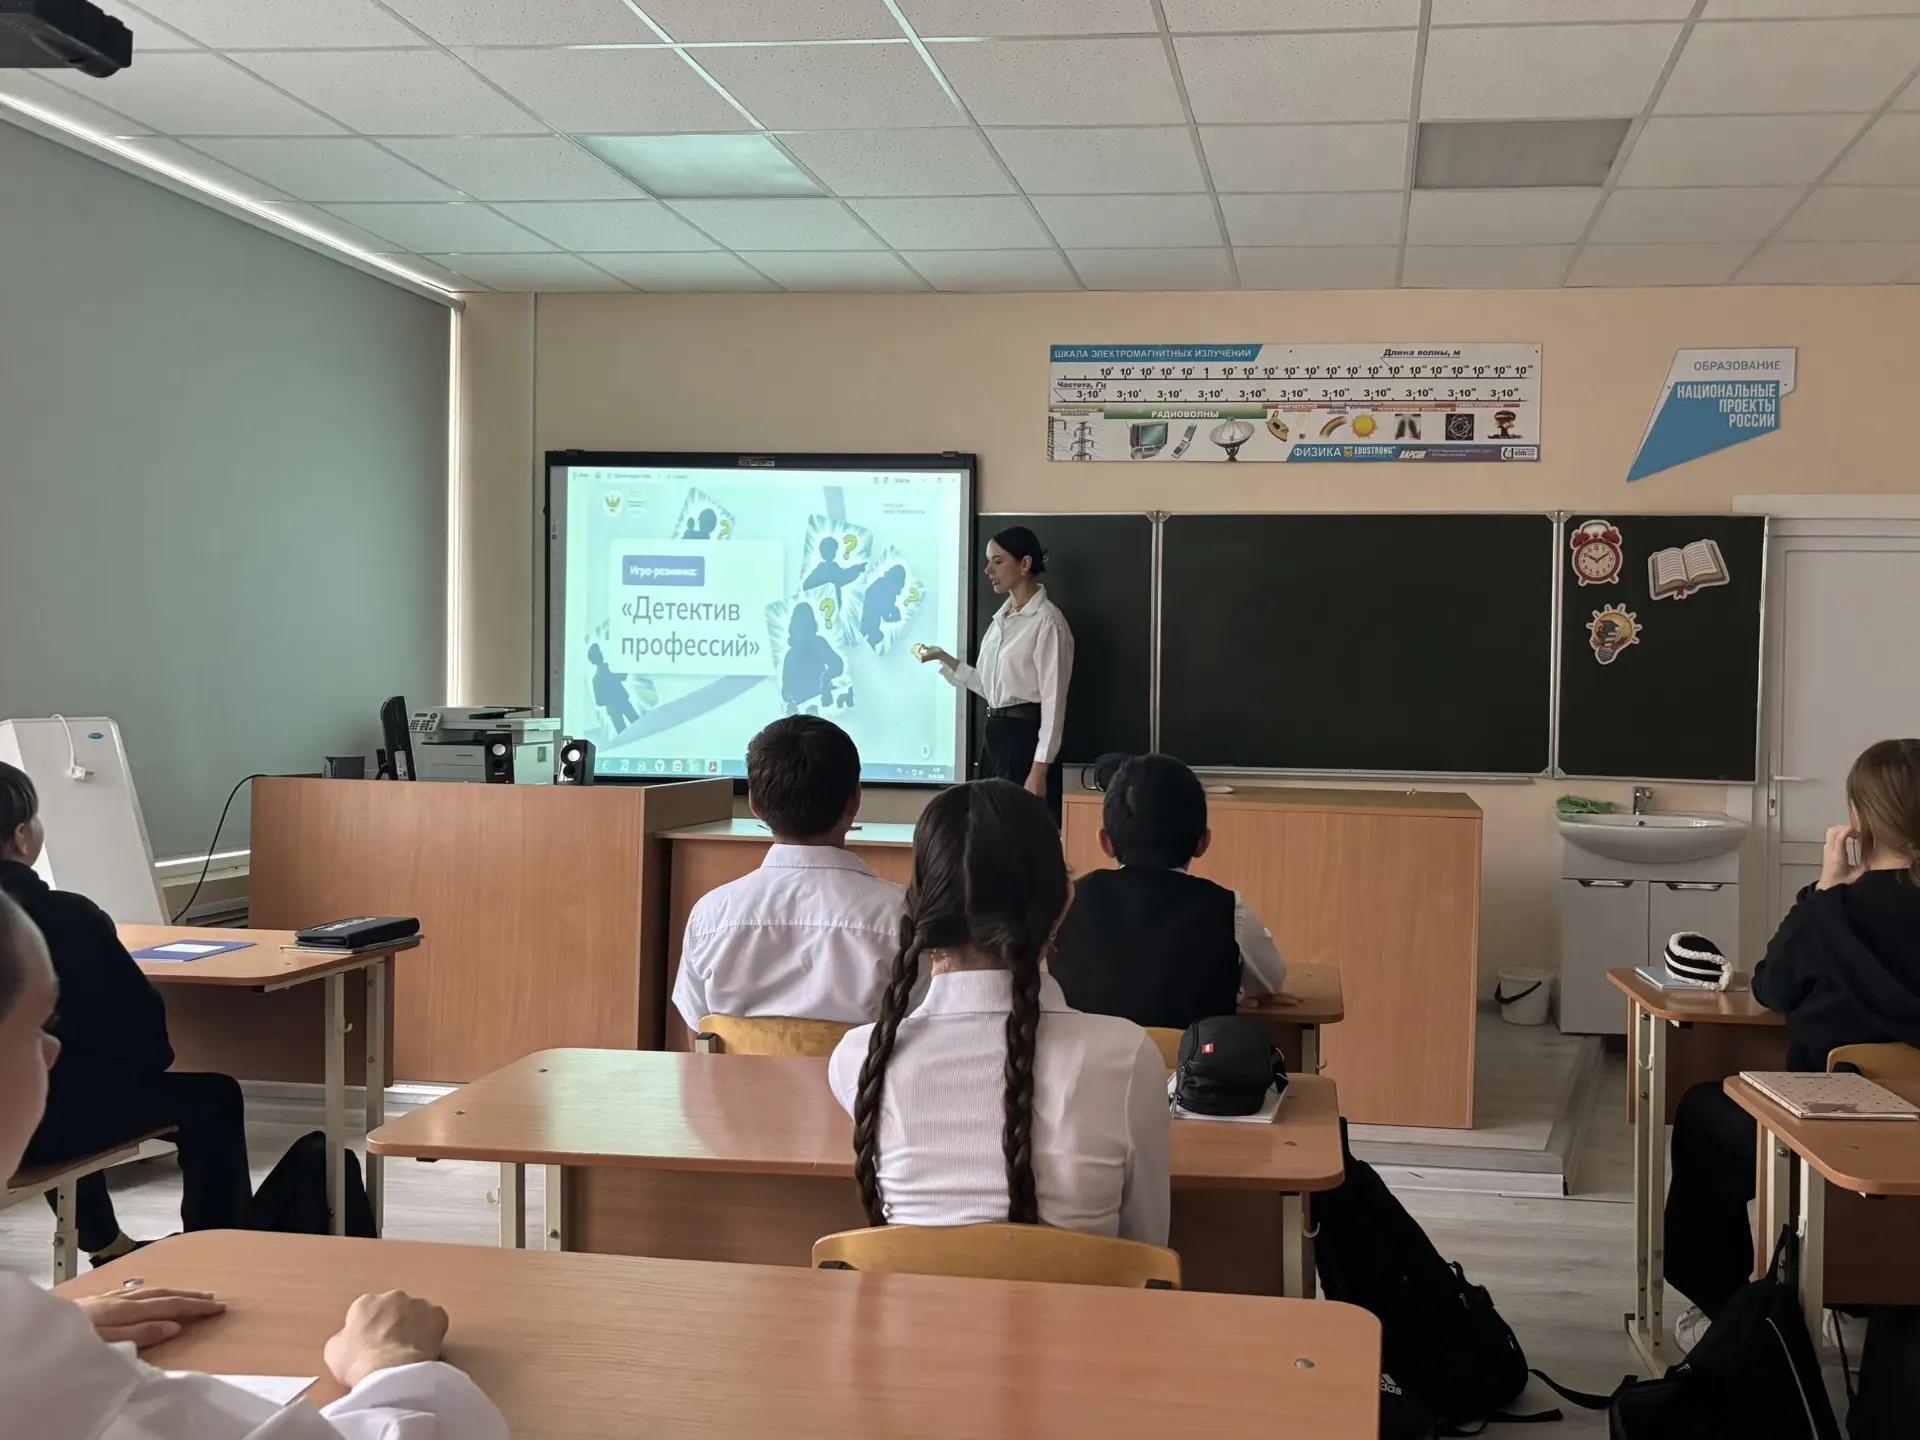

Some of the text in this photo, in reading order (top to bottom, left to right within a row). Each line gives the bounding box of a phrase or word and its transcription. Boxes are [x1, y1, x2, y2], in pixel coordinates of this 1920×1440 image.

[1054, 349, 1089, 359] ШКАЛА
[1091, 349, 1193, 359] ЭЛЕКТРОМАГНИТНЫХ
[1383, 348, 1415, 358] Длина
[1417, 349, 1451, 358] волны,
[1693, 360, 1782, 371] ОБРАЗОВАНИЕ
[1056, 381, 1094, 389] Частота,
[1677, 383, 1776, 399] НАЦИОНАЛЬНЫЕ
[1719, 399, 1776, 413] ПРОЕКТЫ
[1151, 410, 1219, 418] РАДИОВОЛНЫ
[1729, 413, 1775, 428] РОССИИ
[1293, 446, 1341, 457] ФИЗИКА
[621, 595, 741, 625] «Детектив
[621, 630, 760, 663] профессий»
